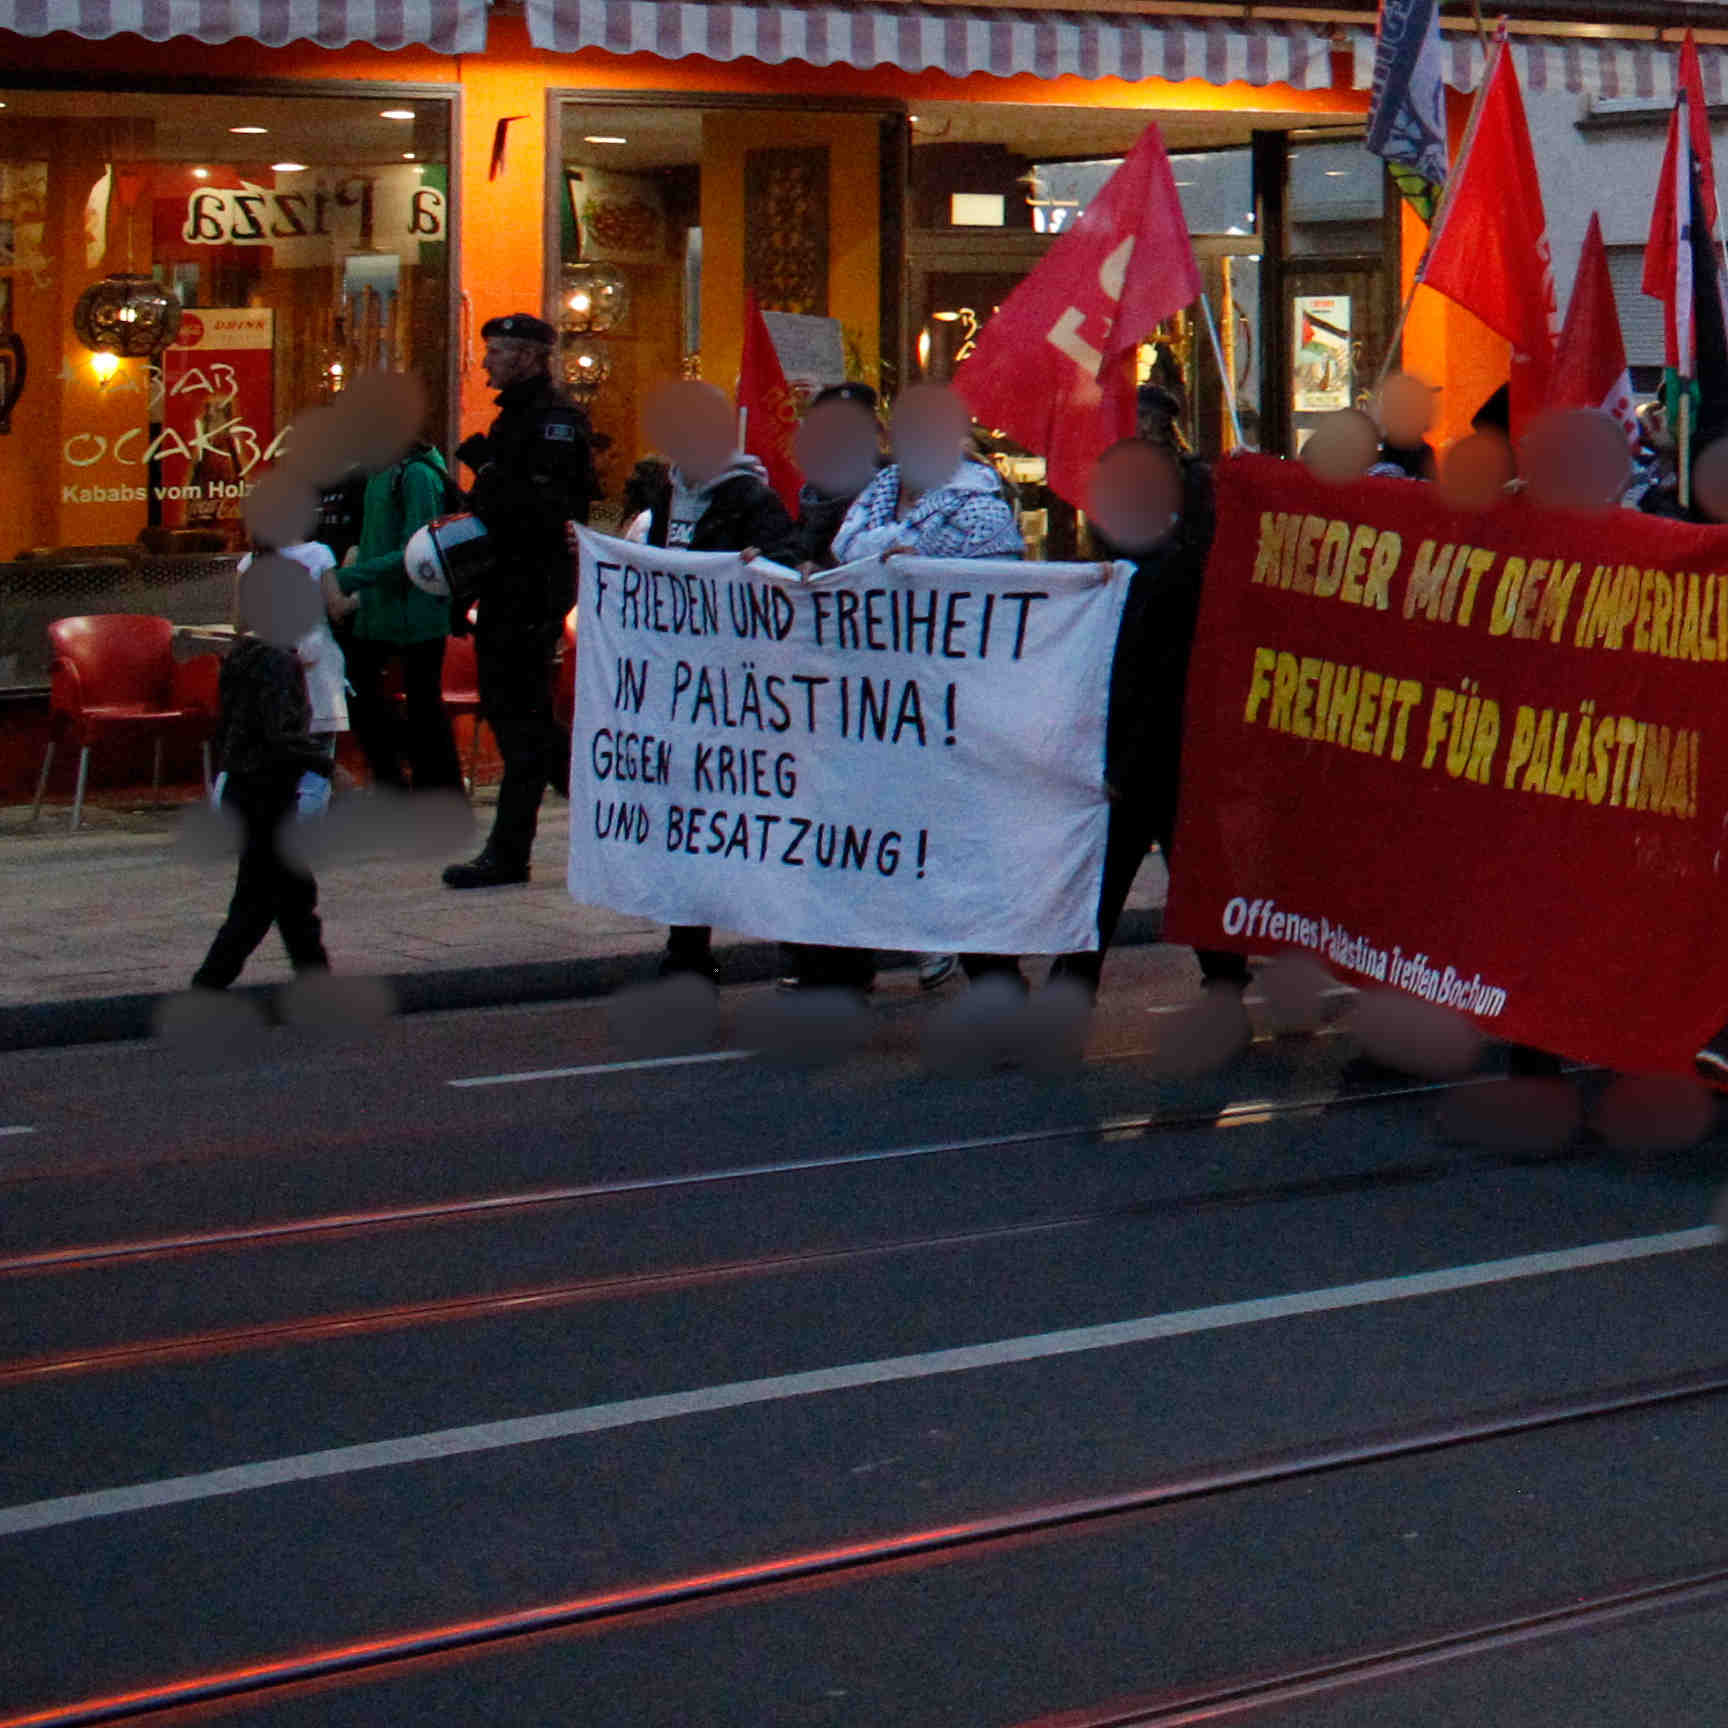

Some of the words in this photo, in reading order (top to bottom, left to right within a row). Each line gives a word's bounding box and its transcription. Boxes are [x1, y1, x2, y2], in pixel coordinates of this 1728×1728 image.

[62, 483, 148, 504] Kababs
[154, 484, 202, 501] vom
[594, 561, 719, 637] FRIEDEN
[730, 575, 795, 642] UND
[813, 588, 1049, 661] FREIHEIT
[1251, 511, 1403, 612] NIEDER
[1402, 539, 1498, 627] MIT
[1490, 555, 1584, 643] DEM
[614, 656, 649, 715] IN
[591, 728, 672, 786] GEGEN
[695, 744, 797, 800] KRIEG
[1244, 646, 1423, 762] FREIHEIT
[1424, 676, 1501, 785] FÜR
[1504, 701, 1702, 820] PALÄSTINA!
[594, 800, 650, 846] UND
[665, 806, 928, 880] BESATZUNG!
[1222, 896, 1320, 949] Offenes
[1389, 945, 1441, 1000] Treffen
[1439, 965, 1508, 1017] Bochum
